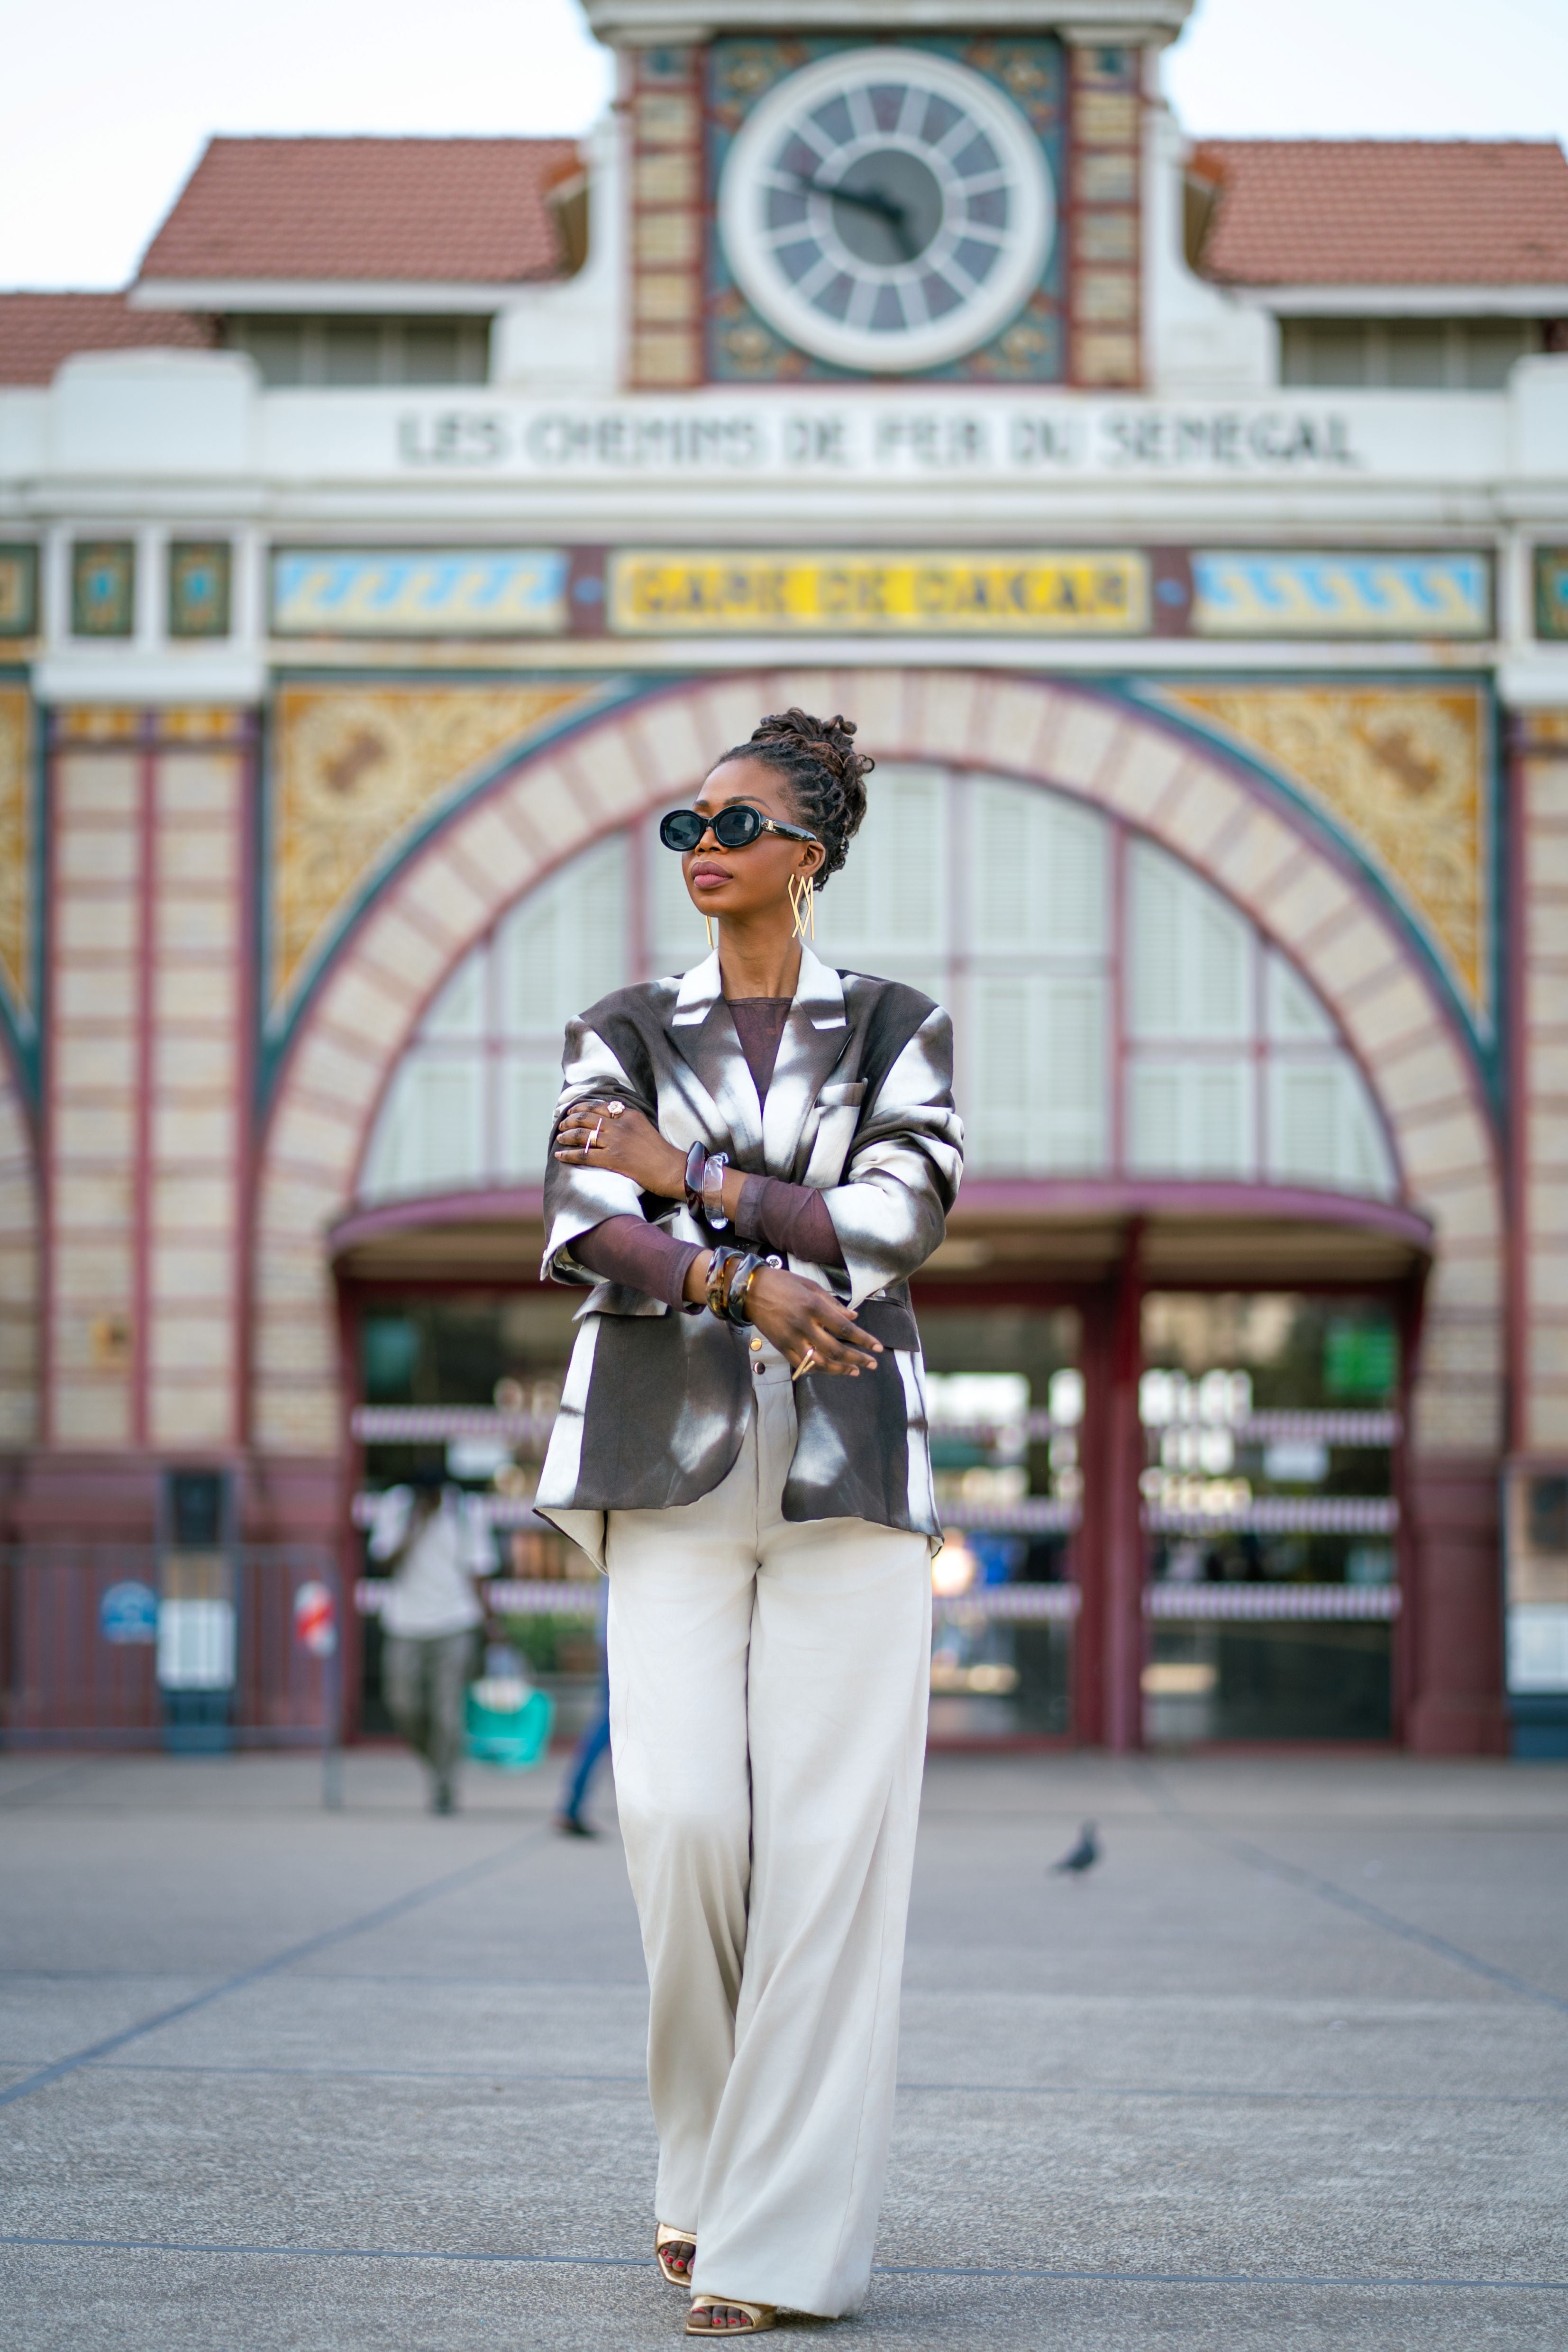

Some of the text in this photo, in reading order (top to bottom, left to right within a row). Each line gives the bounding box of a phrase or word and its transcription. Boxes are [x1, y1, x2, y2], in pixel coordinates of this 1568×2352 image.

[397, 411, 1361, 465] LES CHEMINS DE FER DU SENEGAL
[638, 562, 1129, 620] GARE DE DAKAR
